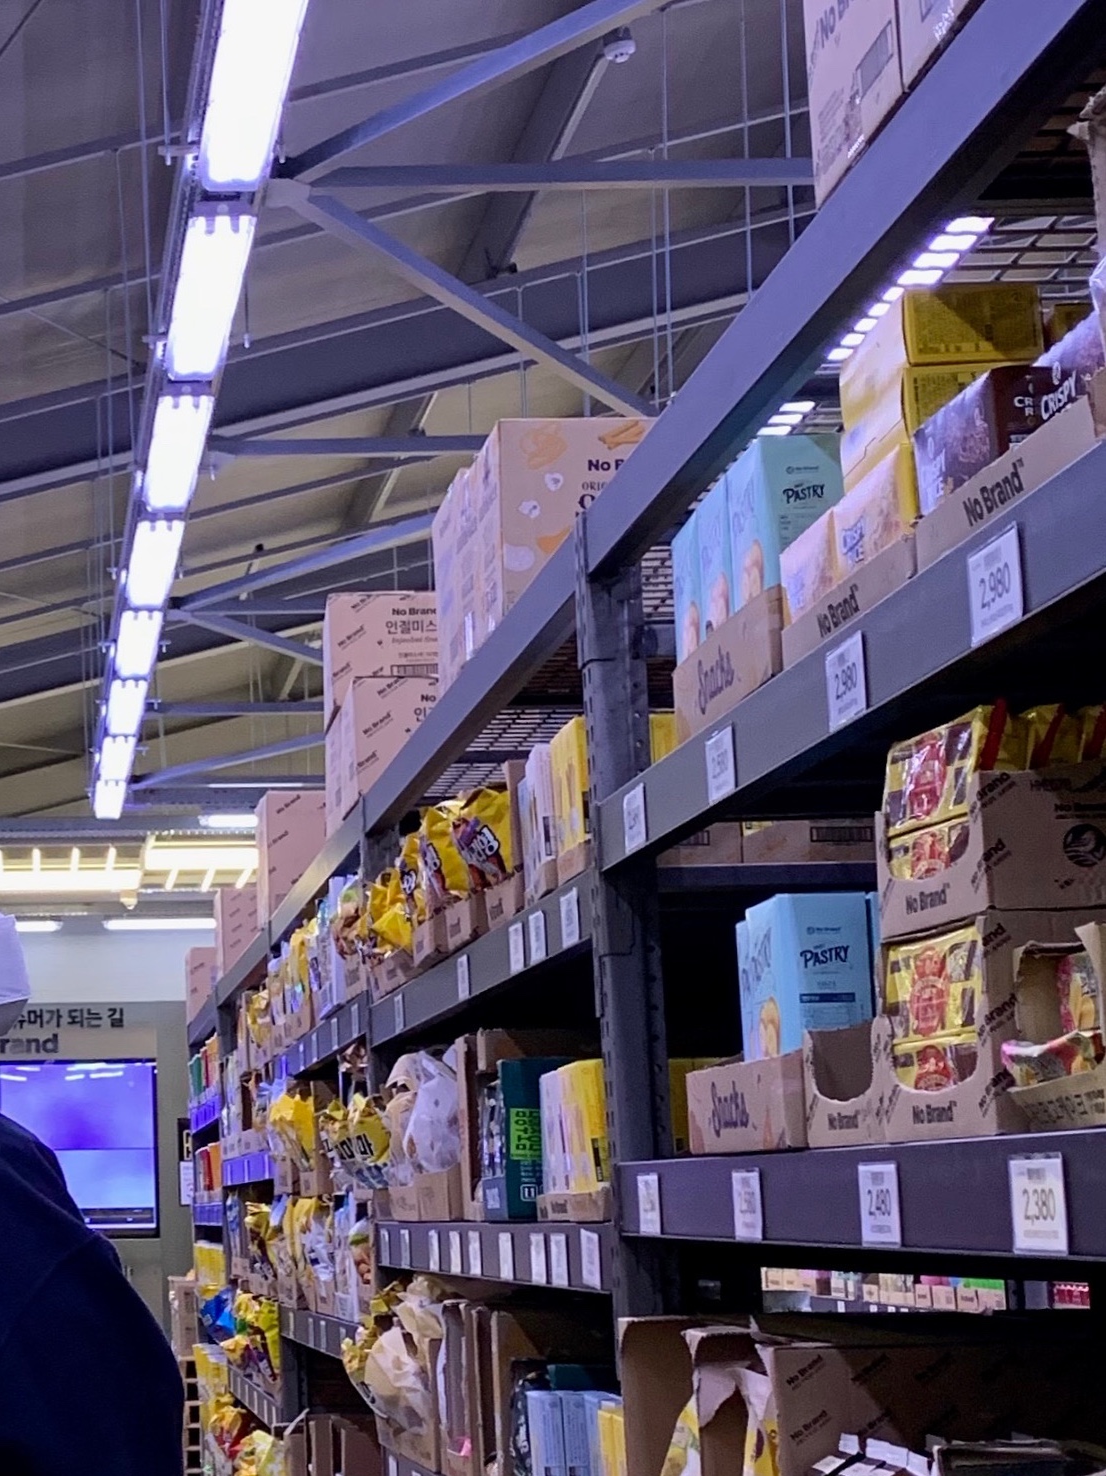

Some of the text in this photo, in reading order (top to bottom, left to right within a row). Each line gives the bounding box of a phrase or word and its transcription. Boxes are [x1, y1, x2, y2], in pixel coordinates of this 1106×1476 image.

[1041, 370, 1077, 421] CRISPY
[588, 459, 611, 471] No
[783, 484, 825, 504] PASTRY
[963, 498, 982, 527] No
[979, 562, 1011, 610] 2,980
[392, 608, 407, 616] No
[818, 613, 831, 638] No
[834, 661, 858, 700] 2,980
[905, 895, 919, 915] No
[800, 945, 850, 969] PASTRY
[67, 1008, 103, 1028] 되는
[107, 1008, 124, 1028] 길
[912, 1105, 925, 1124] No
[1023, 1188, 1056, 1223] 2,380
